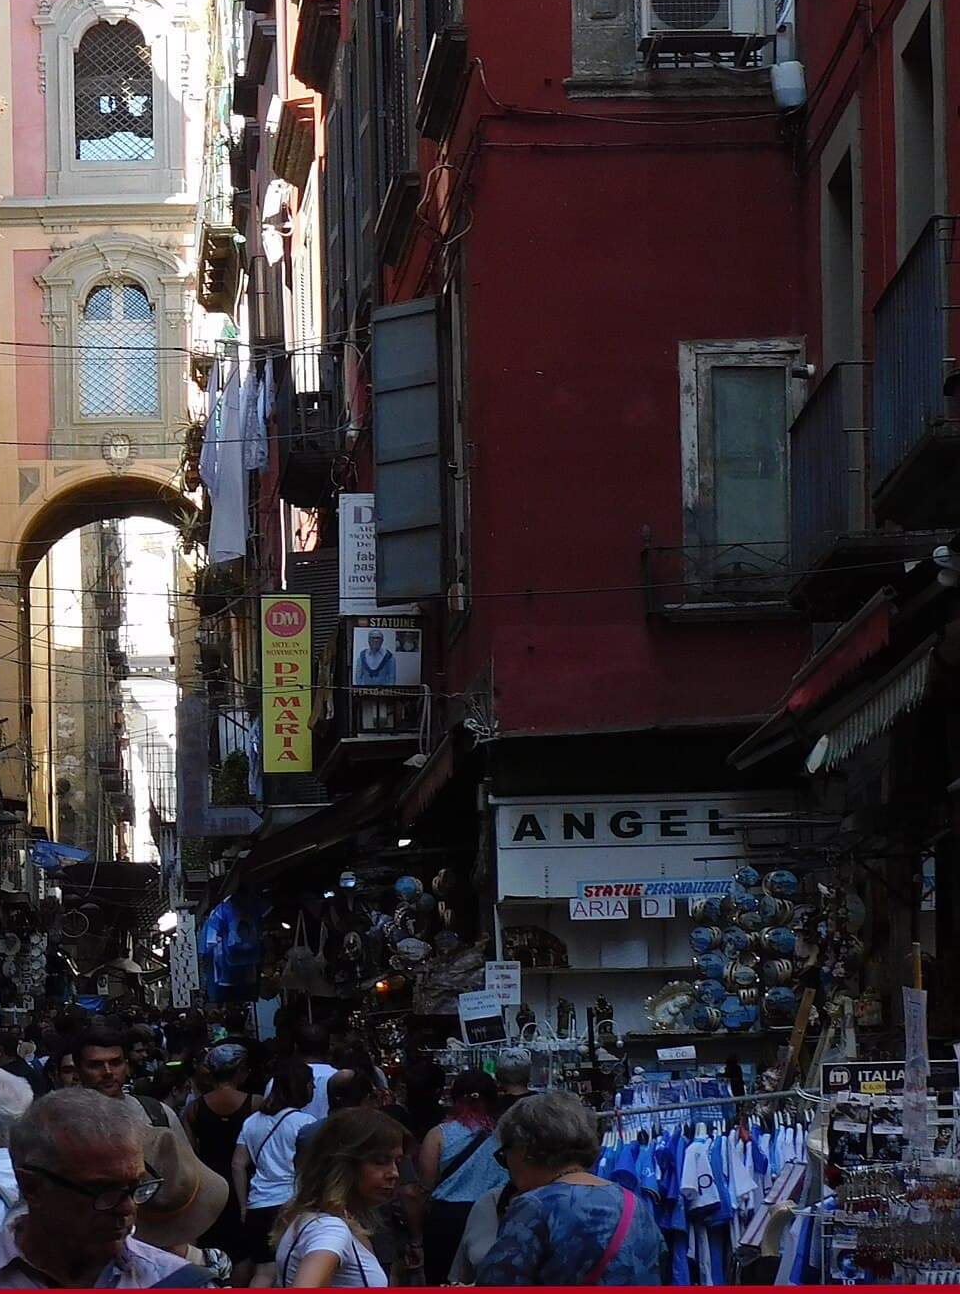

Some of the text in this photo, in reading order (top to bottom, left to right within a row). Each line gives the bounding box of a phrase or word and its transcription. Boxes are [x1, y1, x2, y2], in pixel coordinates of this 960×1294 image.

[353, 505, 375, 524] D
[356, 551, 376, 562] fab
[353, 562, 376, 574] pas
[348, 573, 377, 583] movi
[271, 611, 300, 627] DM
[369, 617, 417, 629] STATUINE
[272, 695, 302, 762] MARIA
[583, 879, 733, 898] STATUE PERSONALIZZATE
[572, 898, 629, 918] ARIA
[857, 1069, 905, 1083] ITALIA
